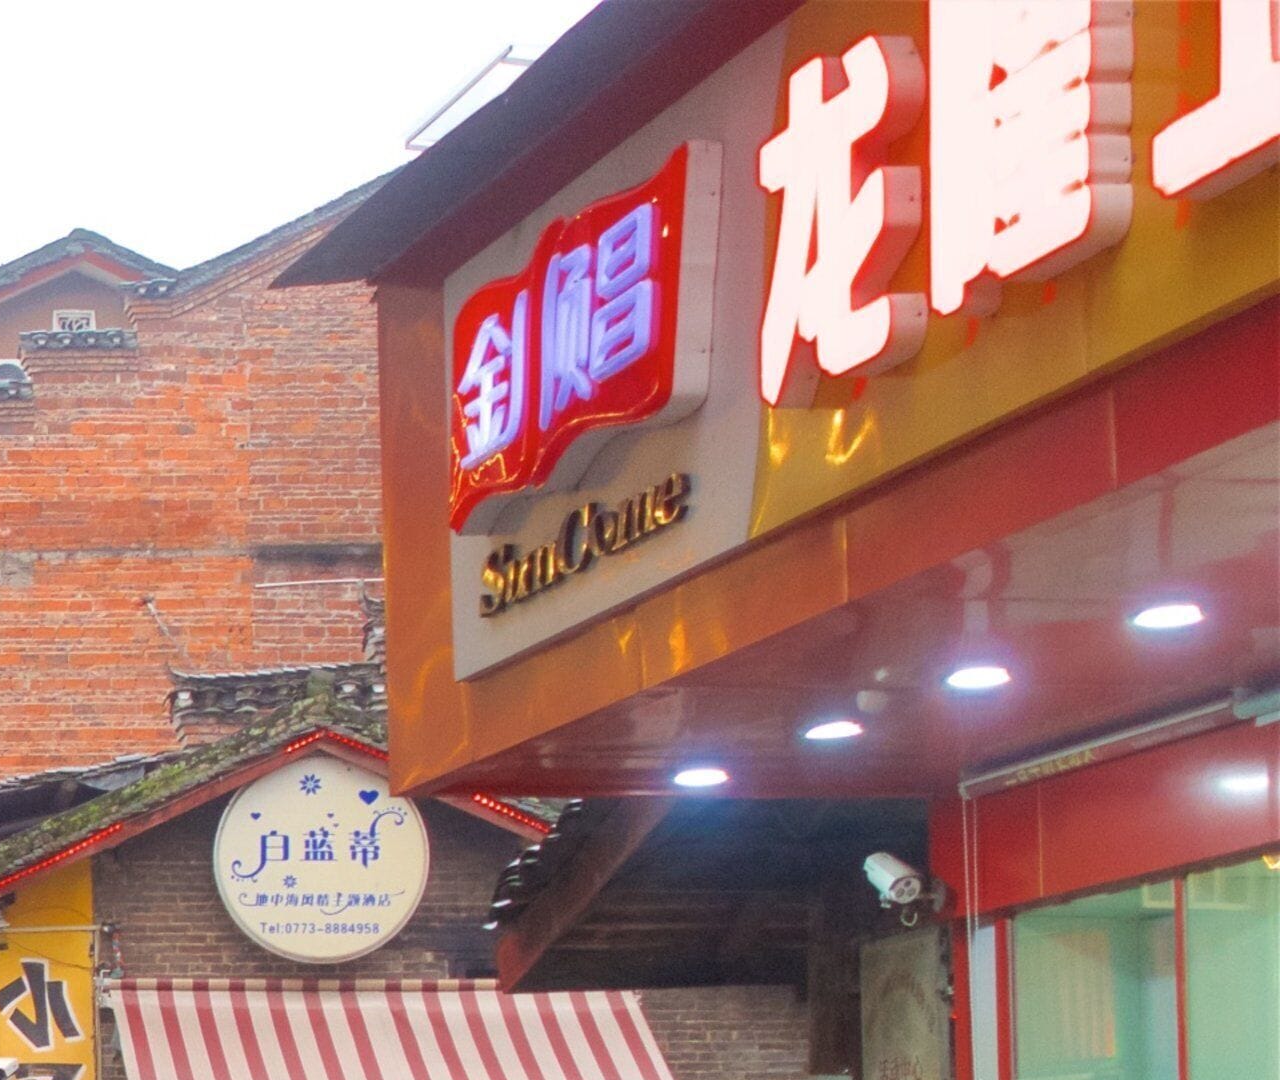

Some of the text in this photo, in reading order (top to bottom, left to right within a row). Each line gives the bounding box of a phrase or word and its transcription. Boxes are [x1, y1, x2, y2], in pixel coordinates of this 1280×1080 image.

[480, 472, 692, 617] SunCome
[235, 822, 390, 876] 白蓝蒂
[259, 922, 380, 934] Tel:0773-8884958
